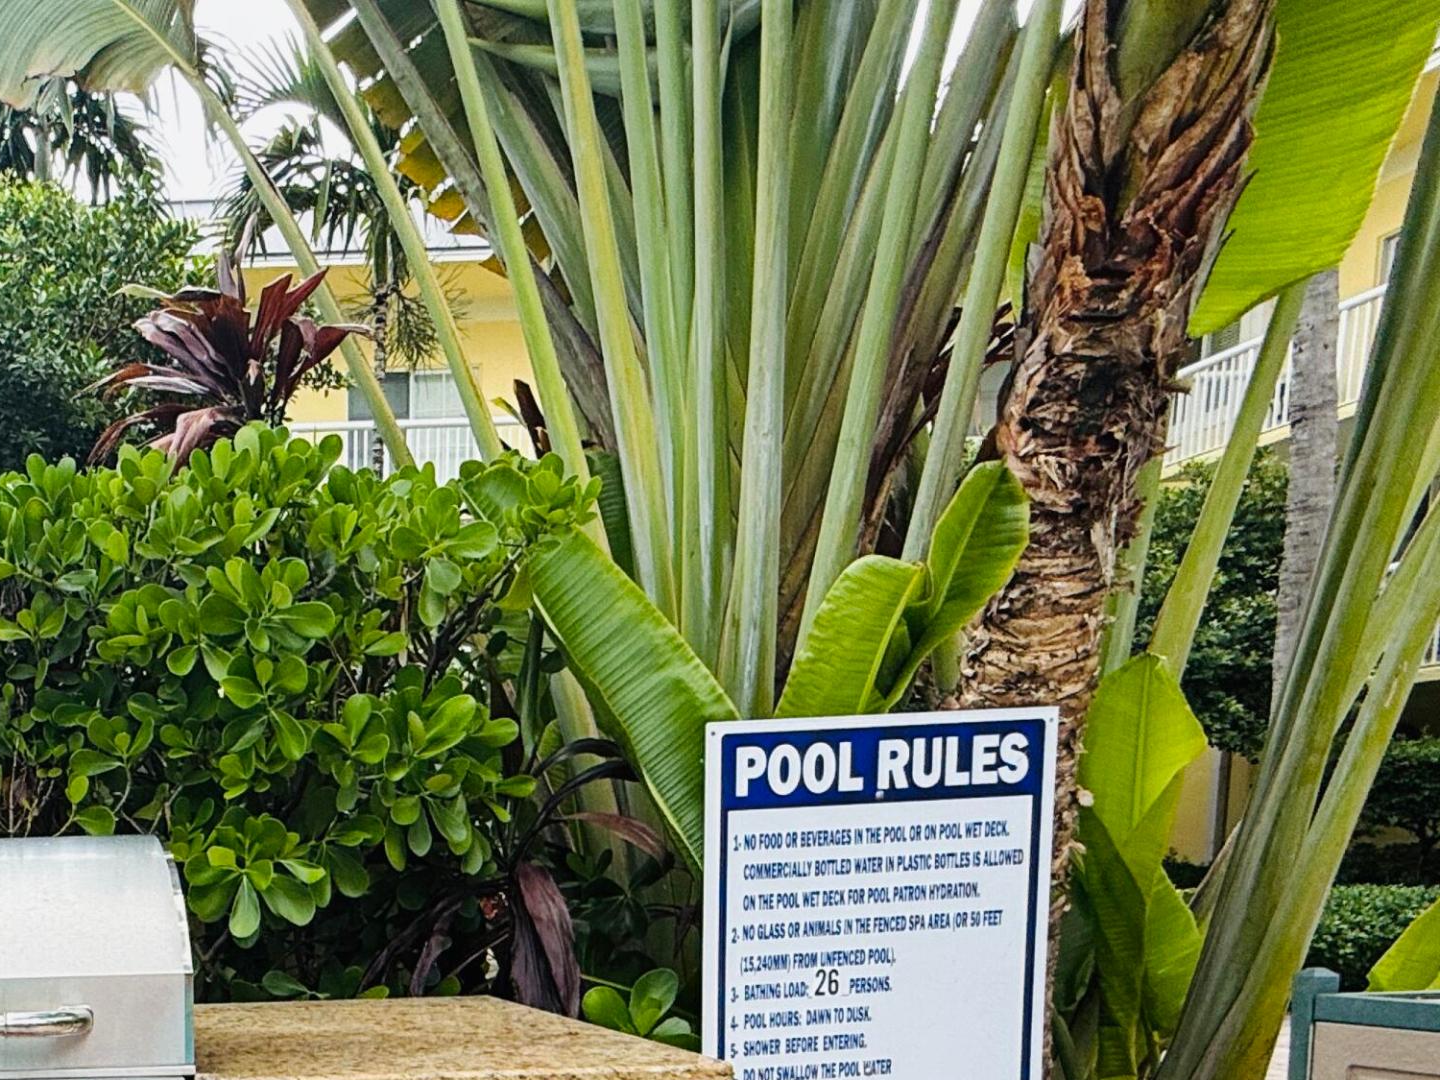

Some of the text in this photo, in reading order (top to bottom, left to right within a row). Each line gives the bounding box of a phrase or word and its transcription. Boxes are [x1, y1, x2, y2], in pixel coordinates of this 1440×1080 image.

[735, 732, 1029, 797] POOL RULES
[743, 834, 756, 850] NO
[759, 832, 783, 850] FOOD
[785, 832, 798, 848] OR
[800, 829, 851, 848] BEVERAGES
[854, 828, 863, 844] IN
[865, 827, 881, 843] THE
[884, 826, 907, 843] POOL
[909, 825, 921, 841] OR
[924, 824, 937, 840] ON
[940, 823, 962, 840] POOL
[965, 821, 982, 838] WET
[743, 849, 1024, 880] COMMERCIALLY BOTTLED WATER IN PLASTIC BOTTLES IS ALLOWED
[743, 882, 980, 911] ON THE POOL WET DECK FOR POOL PATRON HYDRATION.
[742, 924, 754, 941] NO
[757, 923, 786, 940] GLASS
[788, 922, 800, 939] OR
[802, 920, 841, 937] ANIMALS
[844, 919, 852, 935] IN
[855, 918, 871, 934] THE
[873, 915, 906, 933] FENCED
[909, 914, 925, 931] SPA
[928, 913, 950, 929] AREA
[970, 911, 980, 927] 50
[983, 909, 1003, 926] FEET
[793, 952, 818, 969] FROM
[820, 949, 865, 967] UNFENCED
[744, 982, 781, 1001] BATHING
[814, 968, 839, 996] 26
[850, 976, 892, 994] PERSONS.
[744, 1013, 767, 1030] POOL
[769, 1011, 802, 1027] HOURS:
[806, 1009, 831, 1026] DAWN
[834, 1008, 844, 1024] TO
[846, 1006, 872, 1023] DUSK.
[743, 1039, 780, 1057] SHOWER
[785, 1036, 819, 1054] BEFORE
[823, 1033, 867, 1051] ENTERING.
[821, 1063, 837, 1079] THE
[838, 1061, 860, 1078] POOL
